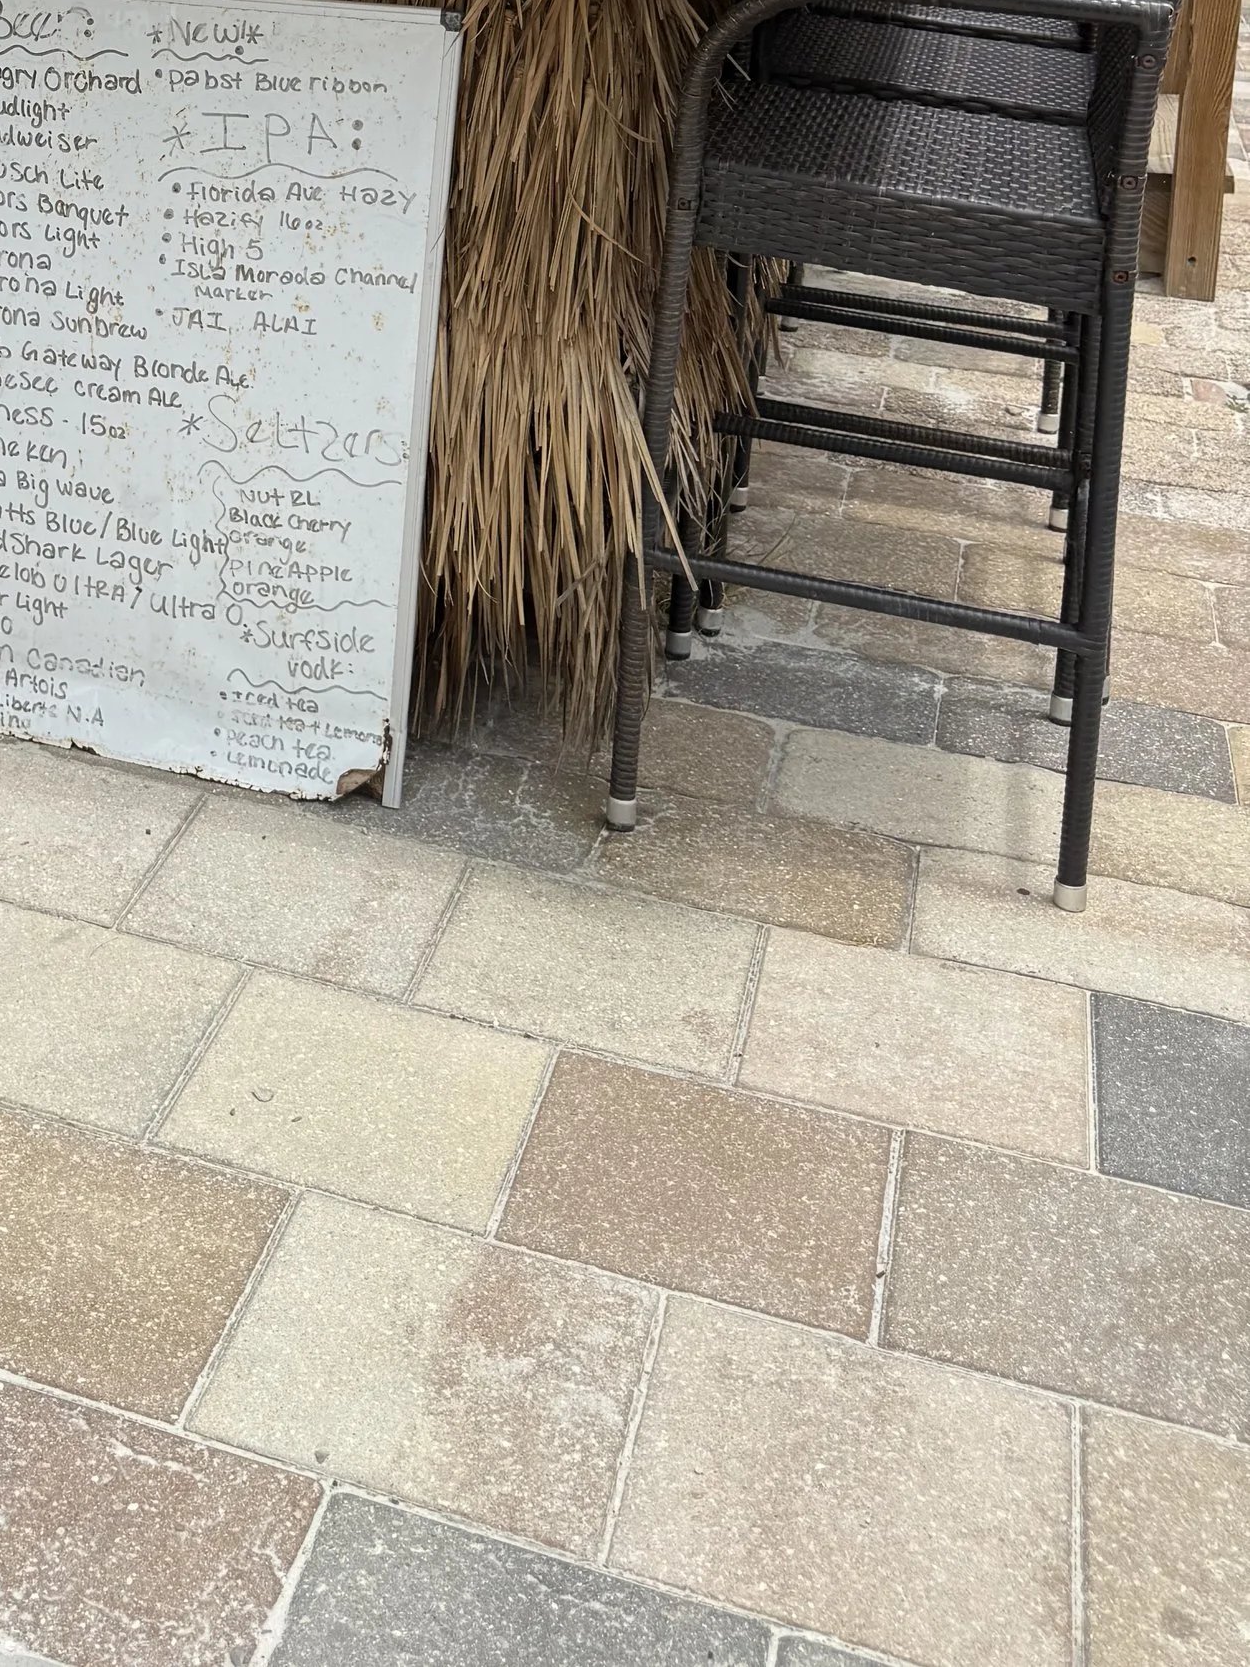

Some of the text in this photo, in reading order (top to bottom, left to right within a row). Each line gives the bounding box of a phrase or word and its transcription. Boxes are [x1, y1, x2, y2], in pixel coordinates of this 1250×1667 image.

[255, 72, 301, 92] Blue
[309, 76, 388, 95] ribbon
[60, 169, 104, 191] Lite
[38, 193, 129, 230] Banquet
[340, 185, 417, 215] Hazy
[45, 224, 100, 258] Light
[182, 233, 264, 272] High 5
[334, 267, 418, 294] Channel
[66, 281, 124, 314] Light
[171, 307, 227, 332] JAI
[22, 341, 121, 381] Gateway
[134, 355, 209, 384] Blonde
[17, 470, 49, 509] Big
[229, 506, 284, 528] Black
[172, 529, 225, 566] Light
[97, 546, 173, 585] Lager
[16, 593, 68, 625] Light
[6, 668, 68, 700] Artois
[286, 697, 319, 714] tea
